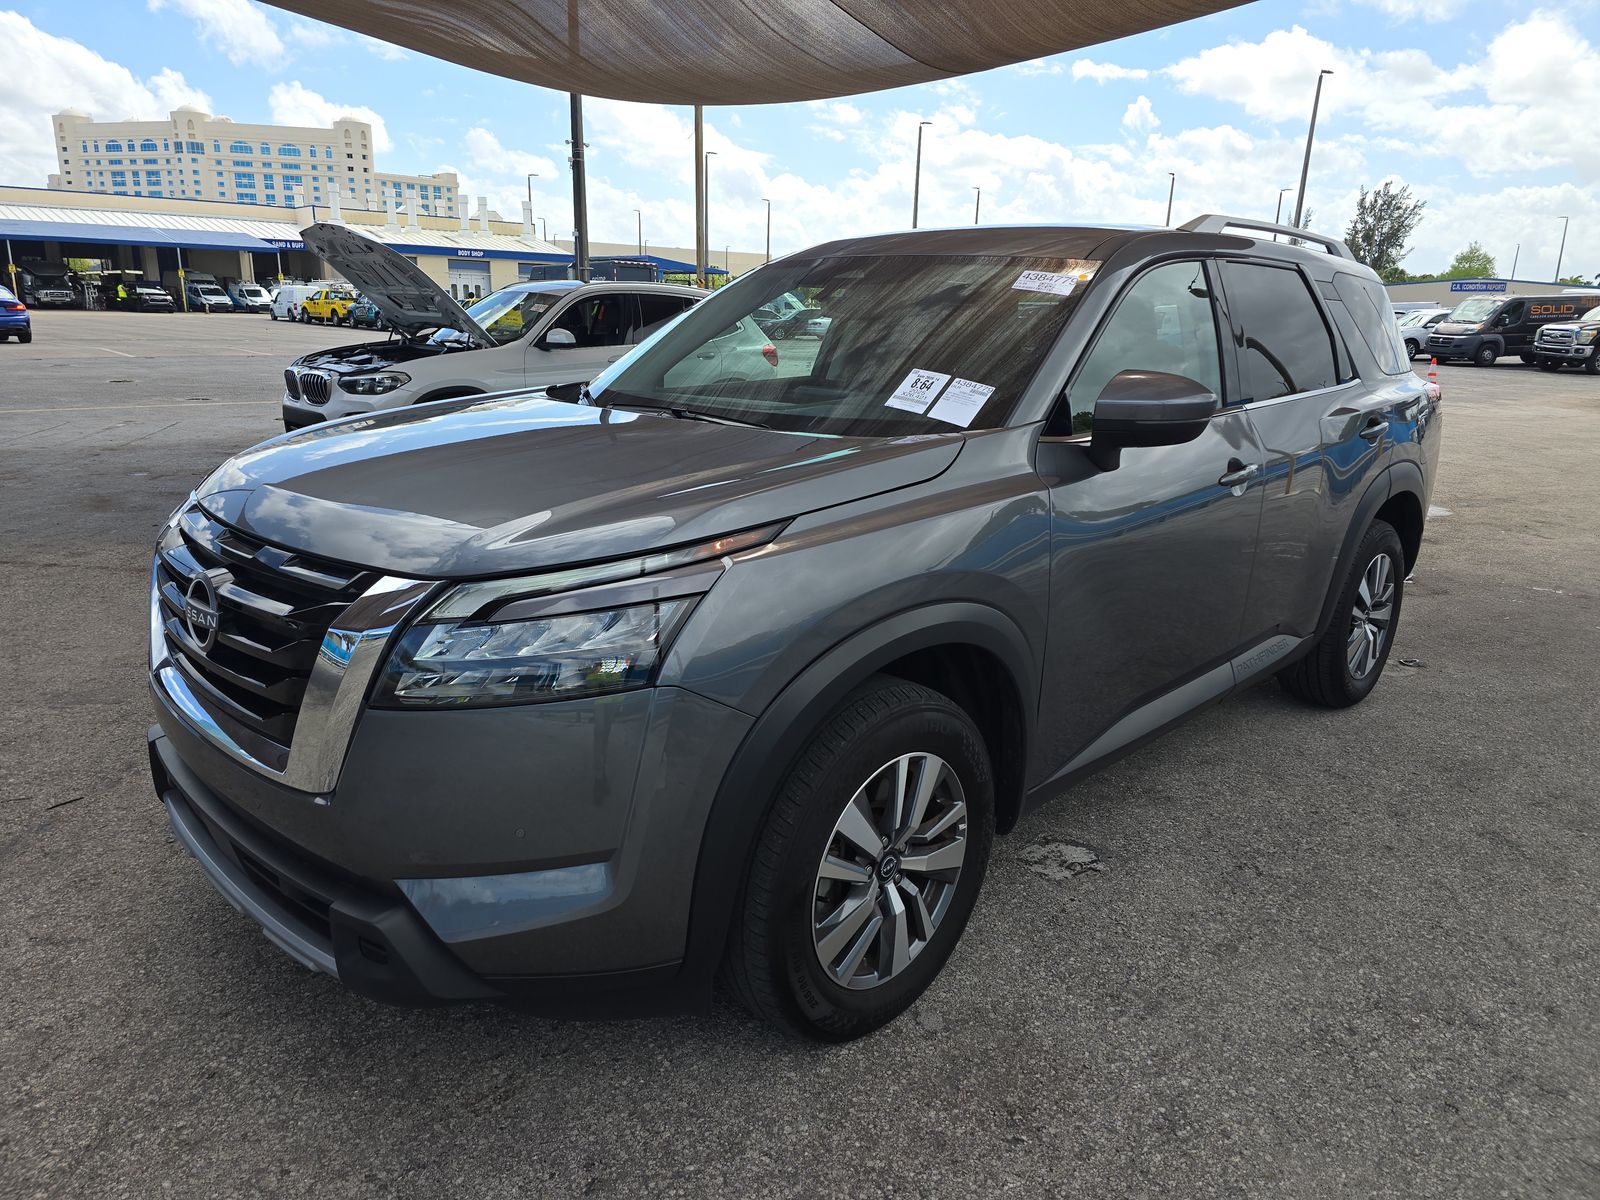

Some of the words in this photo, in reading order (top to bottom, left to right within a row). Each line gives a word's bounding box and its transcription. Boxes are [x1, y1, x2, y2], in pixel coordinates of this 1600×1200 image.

[1022, 272, 1078, 285] 4384779
[1530, 304, 1575, 314] SOLID
[910, 378, 935, 391] 8:64
[955, 379, 994, 394] 4384779
[187, 606, 217, 628] SSAN
[1235, 638, 1289, 674] PATHFINDER
